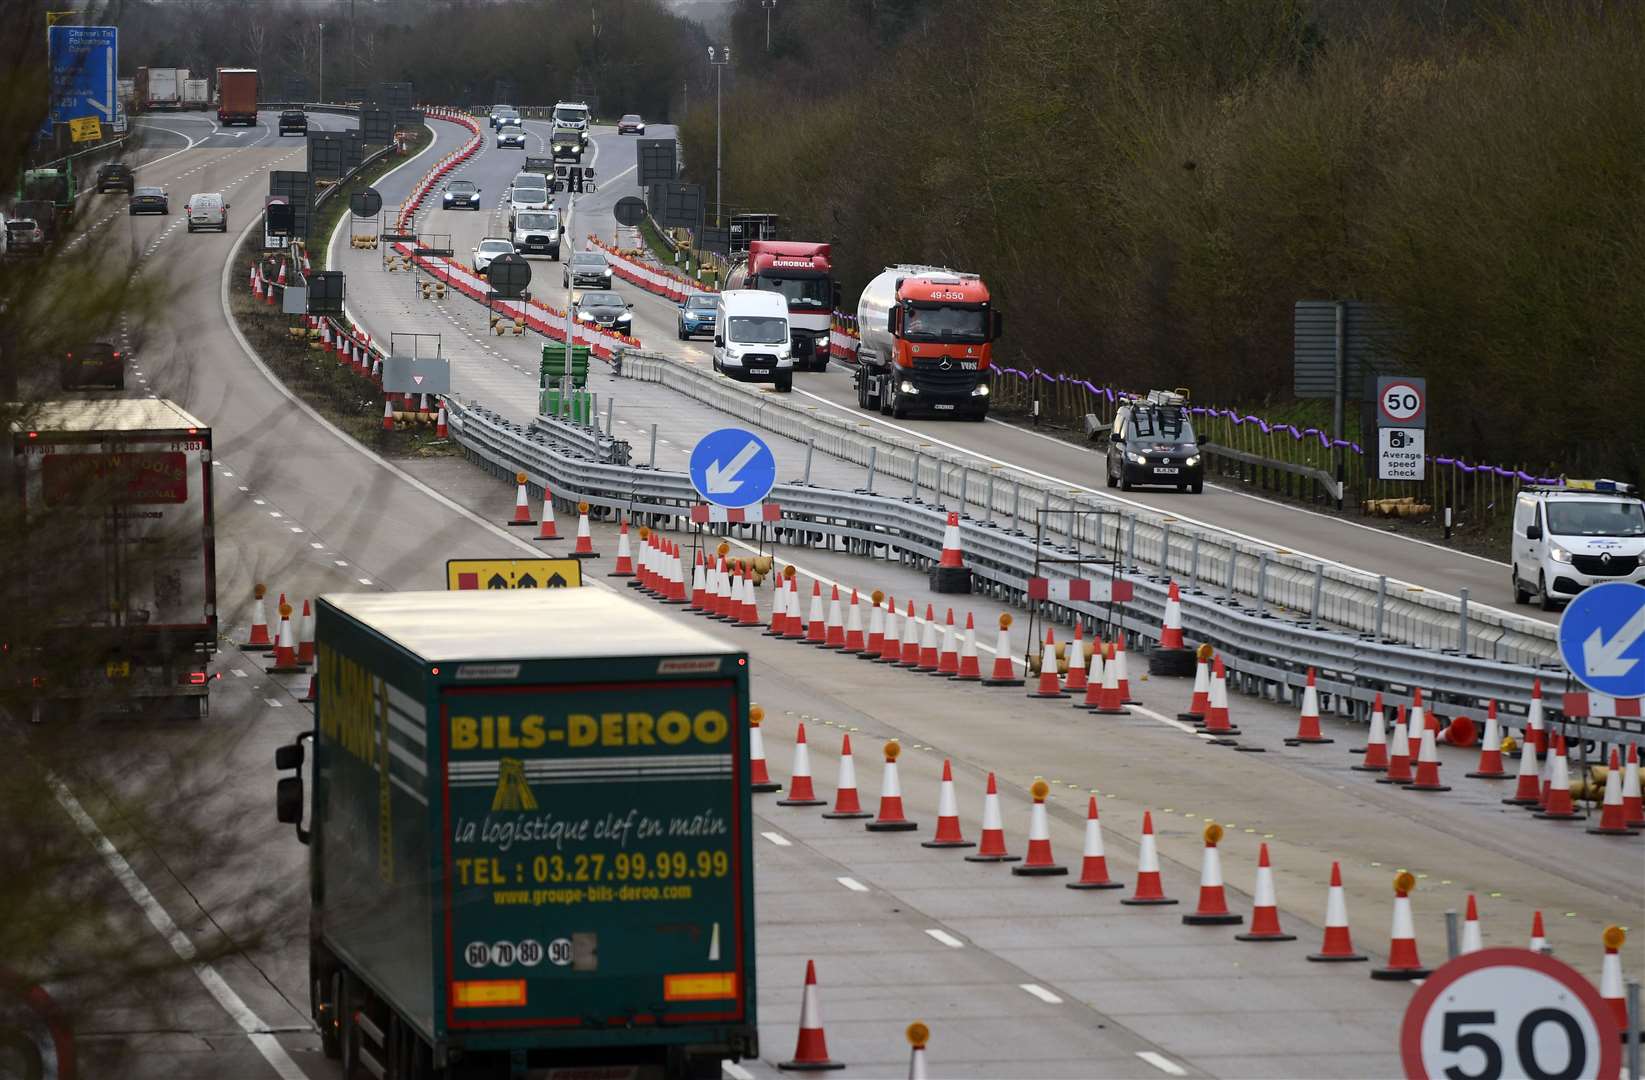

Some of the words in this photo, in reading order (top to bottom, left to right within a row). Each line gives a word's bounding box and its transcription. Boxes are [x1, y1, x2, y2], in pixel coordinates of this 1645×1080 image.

[930, 291, 964, 300] 49-550
[960, 361, 977, 370] VOS
[1388, 394, 1417, 410] 50
[184, 442, 201, 451] 303
[1383, 451, 1421, 460] Average
[1389, 460, 1416, 469] speed
[1388, 469, 1416, 477] check
[450, 710, 729, 750] BILS-DEROO
[455, 817, 475, 842] la
[482, 814, 588, 852] logistique
[594, 808, 638, 846] clef
[638, 821, 664, 838] en
[668, 808, 728, 837] main
[456, 858, 506, 884] TEL
[533, 851, 729, 882] 03.27.99.99.99
[494, 886, 692, 906] www.groupe-bils-deroo.com
[469, 945, 487, 964] 60
[496, 944, 514, 962] 70
[520, 942, 538, 962] 80
[552, 942, 570, 961] 90
[1442, 1008, 1586, 1080] 50
